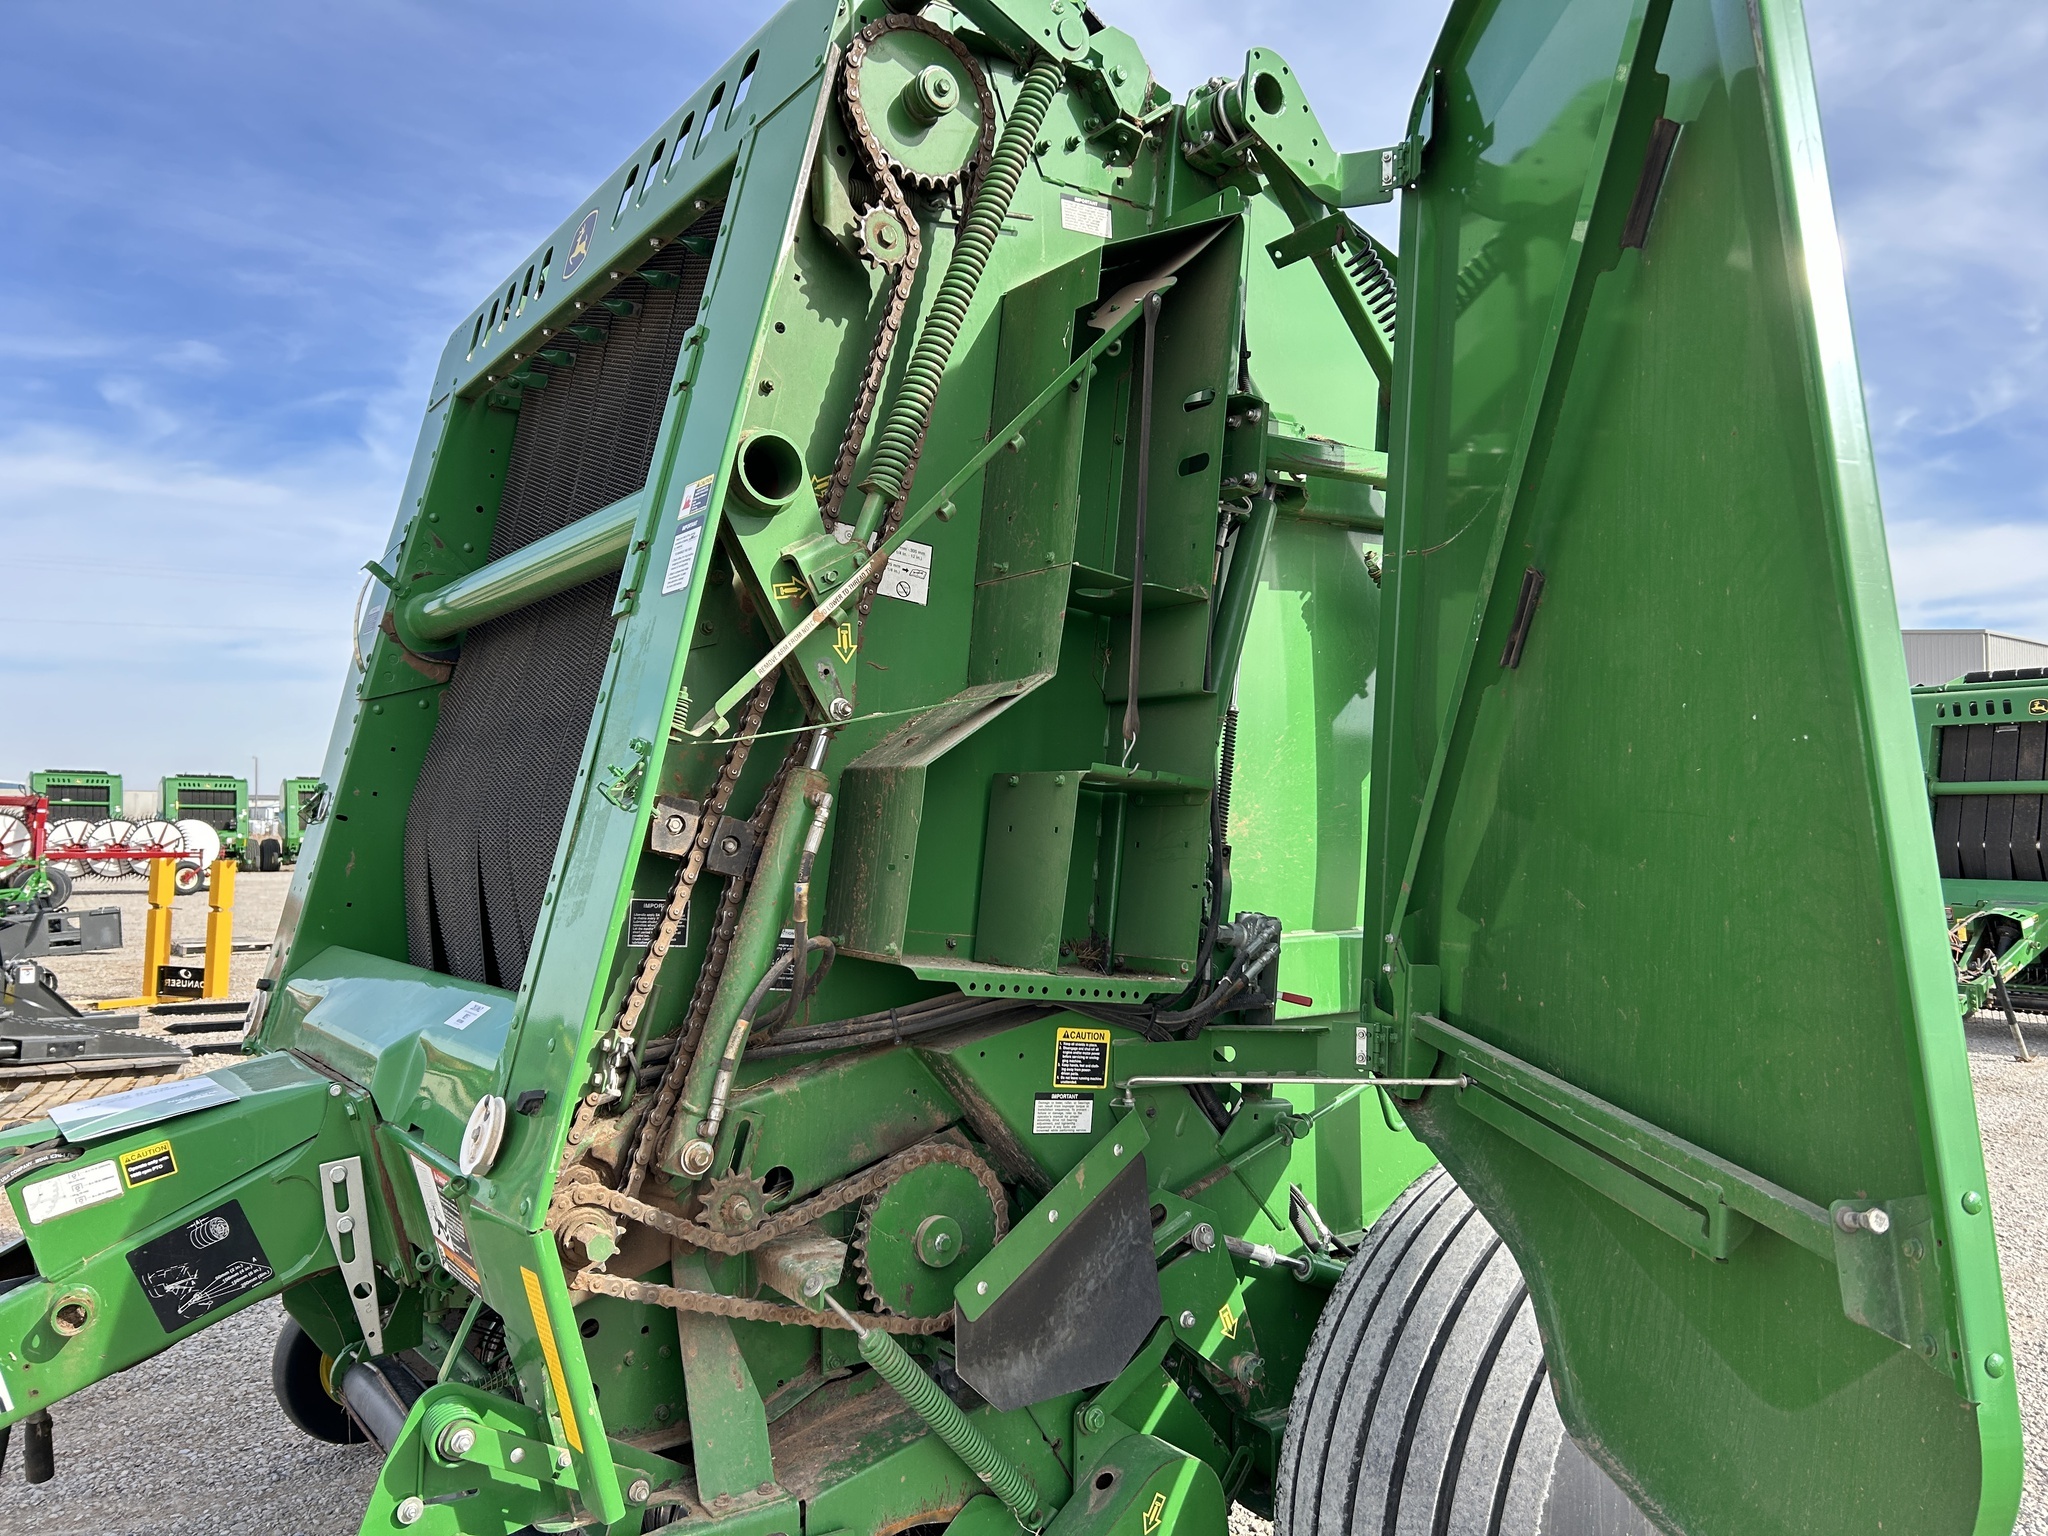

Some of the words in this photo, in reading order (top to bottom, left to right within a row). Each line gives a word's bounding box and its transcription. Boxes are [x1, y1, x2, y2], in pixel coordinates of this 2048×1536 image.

[758, 654, 780, 675] REMOVE
[777, 643, 790, 658] ARM
[788, 631, 803, 647] FROM
[826, 596, 844, 615] LOWER
[848, 572, 868, 592] THREAD
[1070, 1031, 1105, 1041] CAUTION
[130, 1144, 168, 1161] CAUTION
[152, 1164, 164, 1172] PTO
